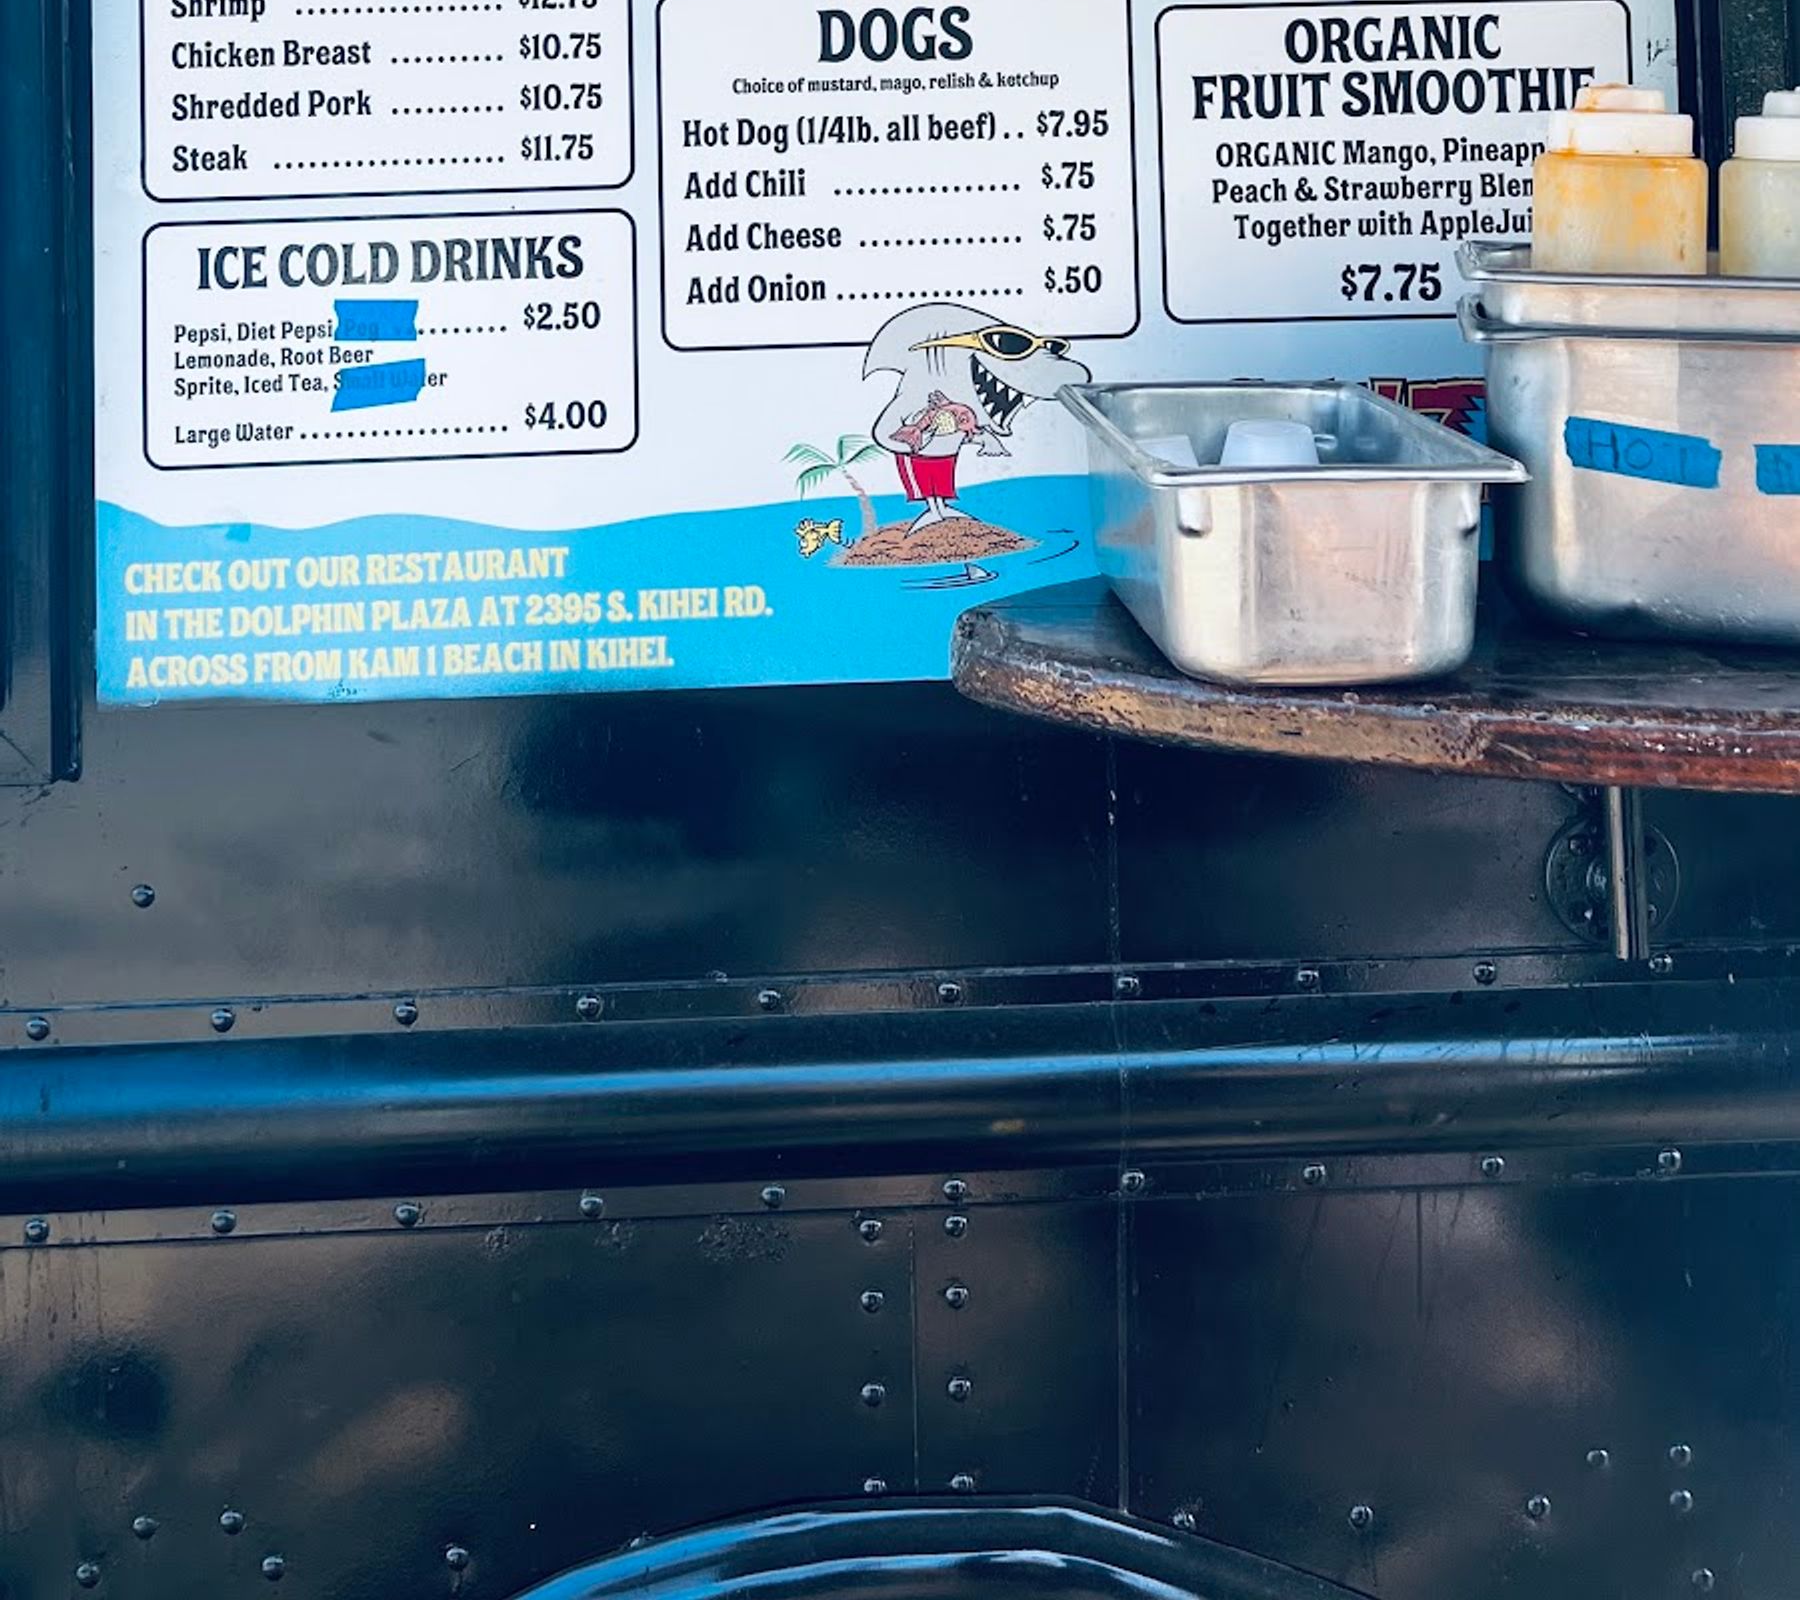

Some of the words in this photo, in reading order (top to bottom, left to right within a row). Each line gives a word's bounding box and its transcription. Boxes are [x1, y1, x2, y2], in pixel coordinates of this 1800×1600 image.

[816, 5, 973, 62] DOGS
[1284, 13, 1501, 63] ORGANIC
[732, 77, 784, 94] Choice
[787, 77, 805, 93] of
[807, 75, 877, 91] mustard,
[880, 77, 925, 94] mayo,
[929, 72, 975, 89] relish
[977, 71, 993, 88] &
[996, 71, 1059, 89] ketchup
[1191, 71, 1330, 119] FRUIT
[682, 119, 729, 147] Hot
[736, 118, 788, 150] Dog
[886, 114, 920, 141] all
[927, 111, 995, 140] beef)
[1036, 108, 1108, 137] $7.95
[1211, 177, 1287, 203] Peach
[1294, 176, 1317, 202] &
[1323, 174, 1472, 202] Strawberry
[1479, 172, 1533, 197] Blen
[196, 245, 267, 289] ICE
[278, 241, 398, 287] COLD
[410, 234, 583, 282] DRINKS
[1341, 261, 1441, 301] $7.75
[174, 322, 231, 346] Pepsi,
[237, 321, 275, 341] Diet
[523, 300, 600, 330] $2.50
[175, 425, 230, 446] Large
[235, 422, 293, 441] Water
[524, 399, 606, 429] $4.00
[124, 560, 222, 594] CHECK
[227, 557, 290, 591] OUT
[294, 554, 360, 588] OUR
[365, 547, 568, 585] RESTAURANT
[125, 609, 158, 641] IN
[161, 606, 224, 640] THE
[227, 599, 366, 639] DOLPHIN
[368, 595, 472, 633] PLAZA
[477, 594, 521, 627] AT
[524, 592, 601, 625] 2395
[606, 590, 633, 622] S.
[638, 588, 717, 620] KIHEI
[724, 585, 772, 616] RD.
[126, 652, 248, 687] ACROSS
[253, 648, 342, 683] FROM
[346, 645, 420, 681] KAM
[442, 640, 542, 676] BEACH
[549, 639, 579, 670] IN
